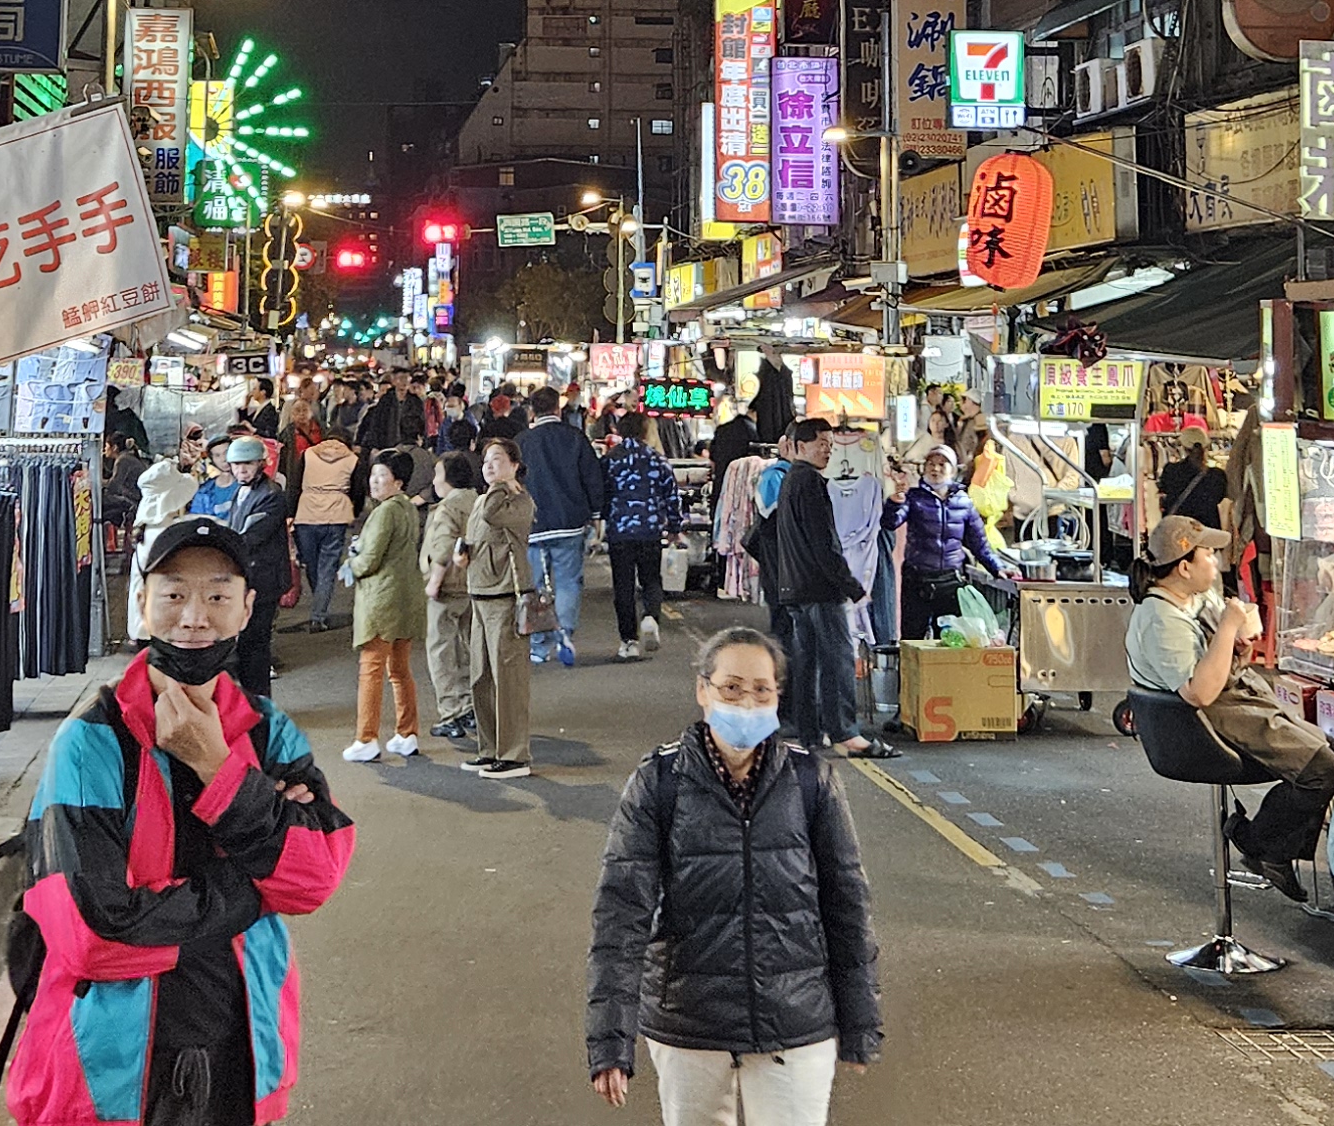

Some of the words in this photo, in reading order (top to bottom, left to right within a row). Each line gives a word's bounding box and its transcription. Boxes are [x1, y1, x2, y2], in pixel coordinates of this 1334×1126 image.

[778, 90, 815, 189] 徐立信
[911, 118, 944, 131] 訂位專
[722, 163, 767, 200] 38
[62, 280, 162, 330] 艋舺紅豆餅
[231, 356, 266, 373] 3C
[646, 385, 709, 411] 燒仙草
